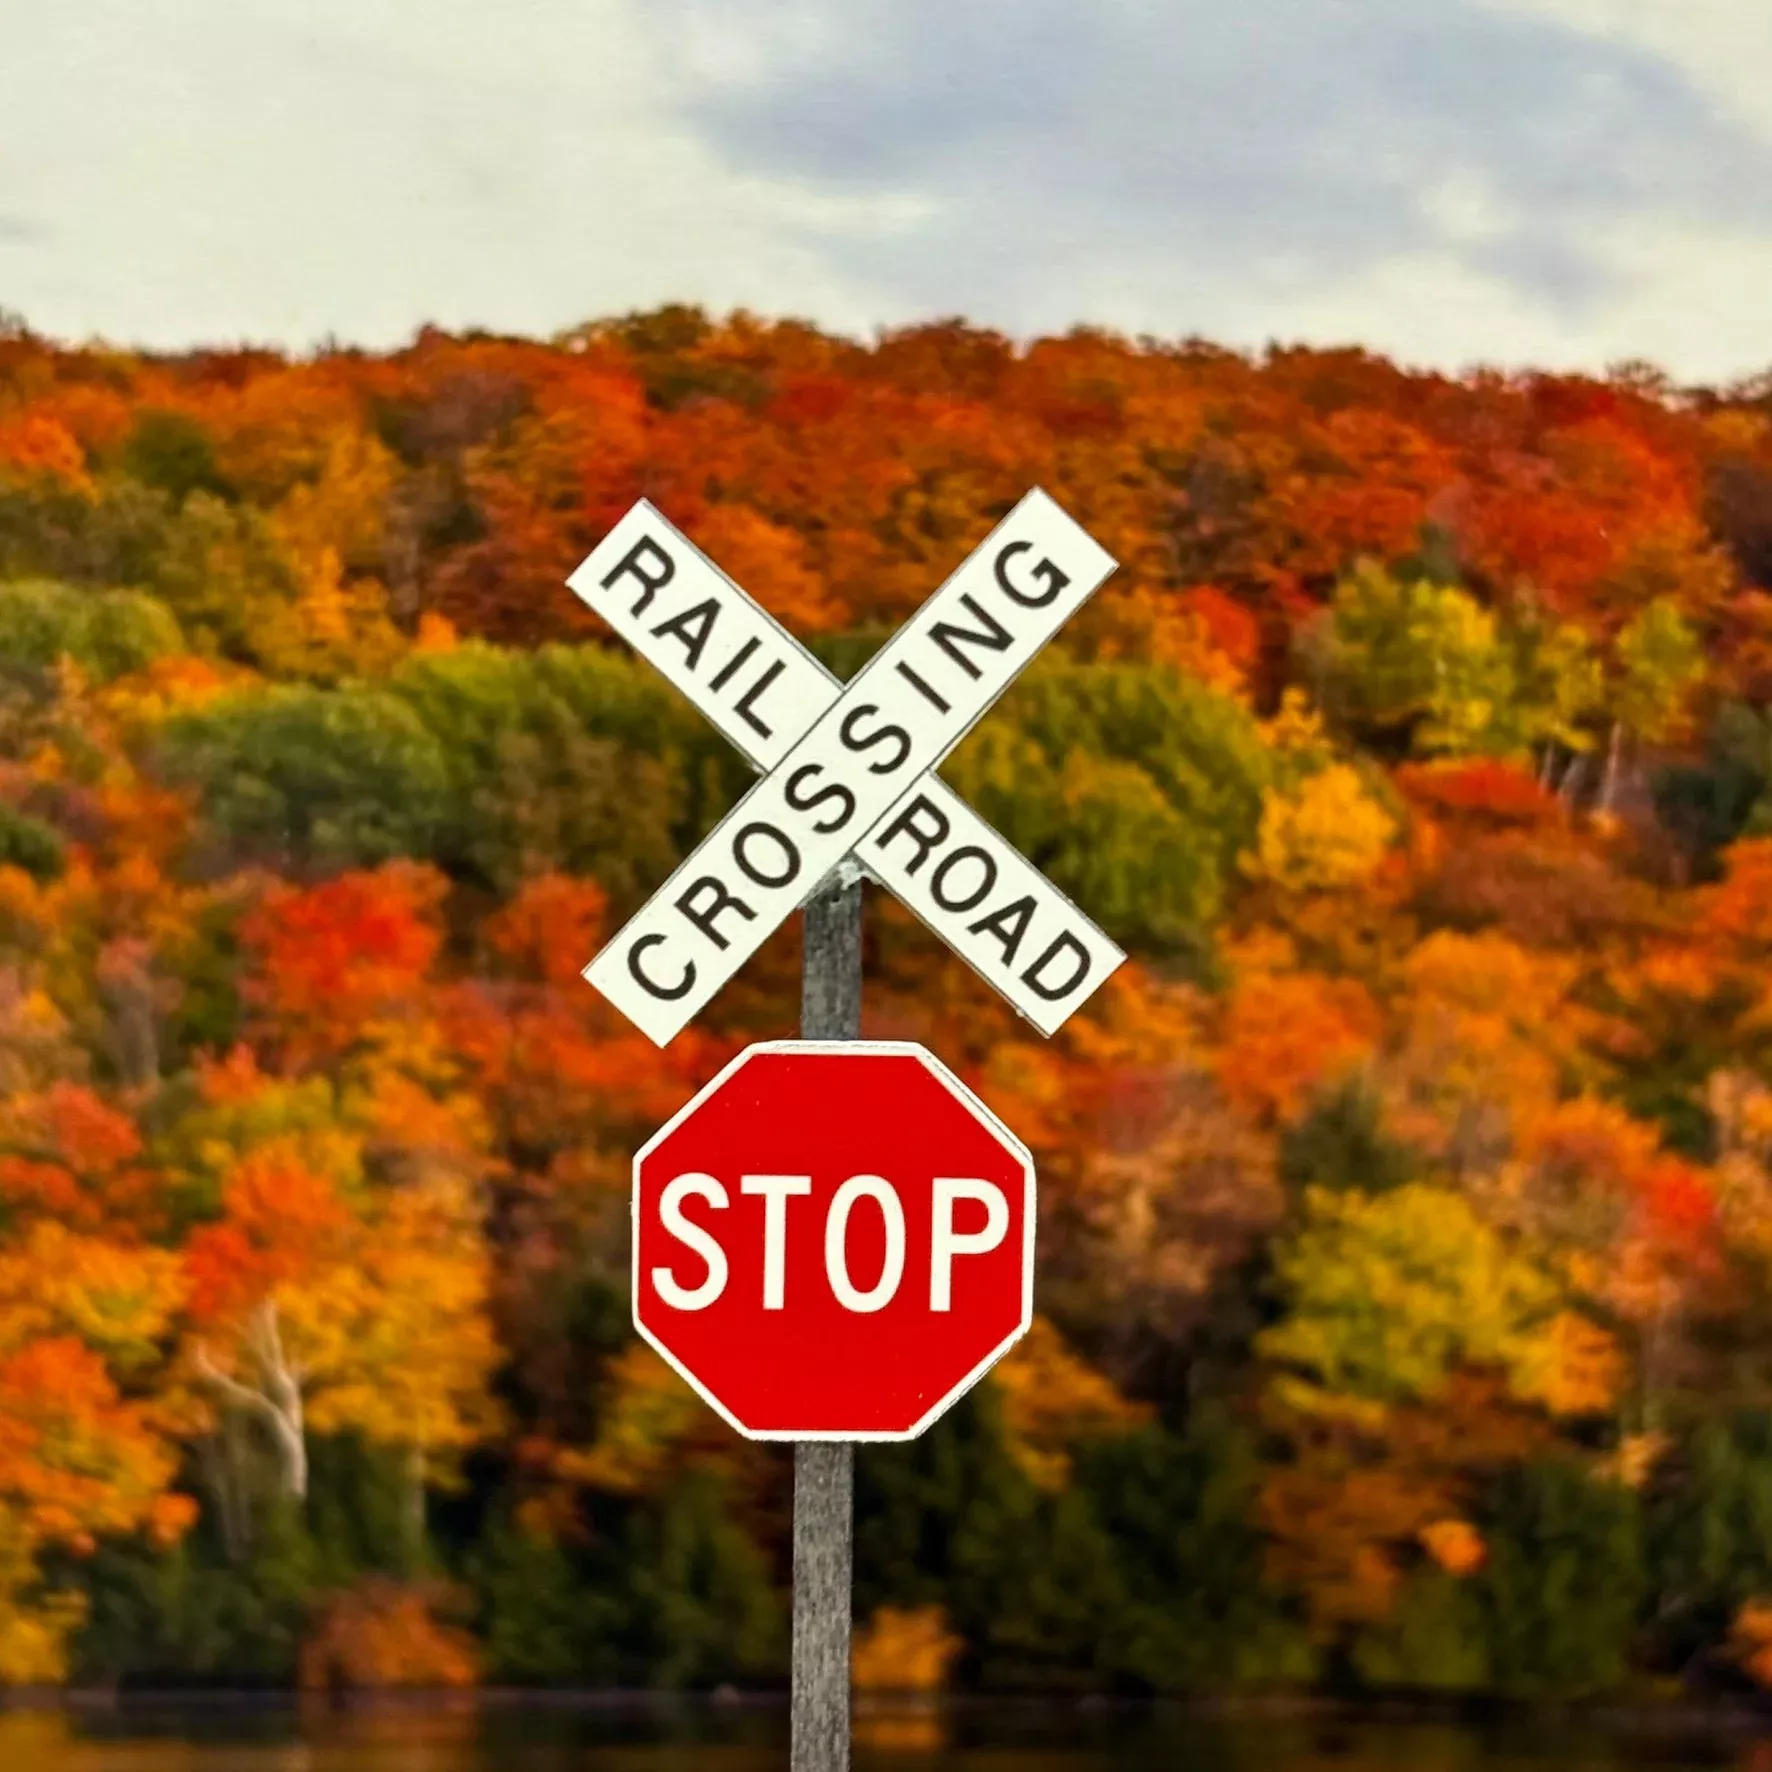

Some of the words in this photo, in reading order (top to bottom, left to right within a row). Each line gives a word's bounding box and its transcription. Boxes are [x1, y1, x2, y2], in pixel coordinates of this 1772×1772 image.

[600, 534, 787, 740] RAIL
[875, 793, 1092, 1002] ROAD
[626, 540, 1071, 1002] CROSSING
[651, 1172, 1010, 1313] STOP
